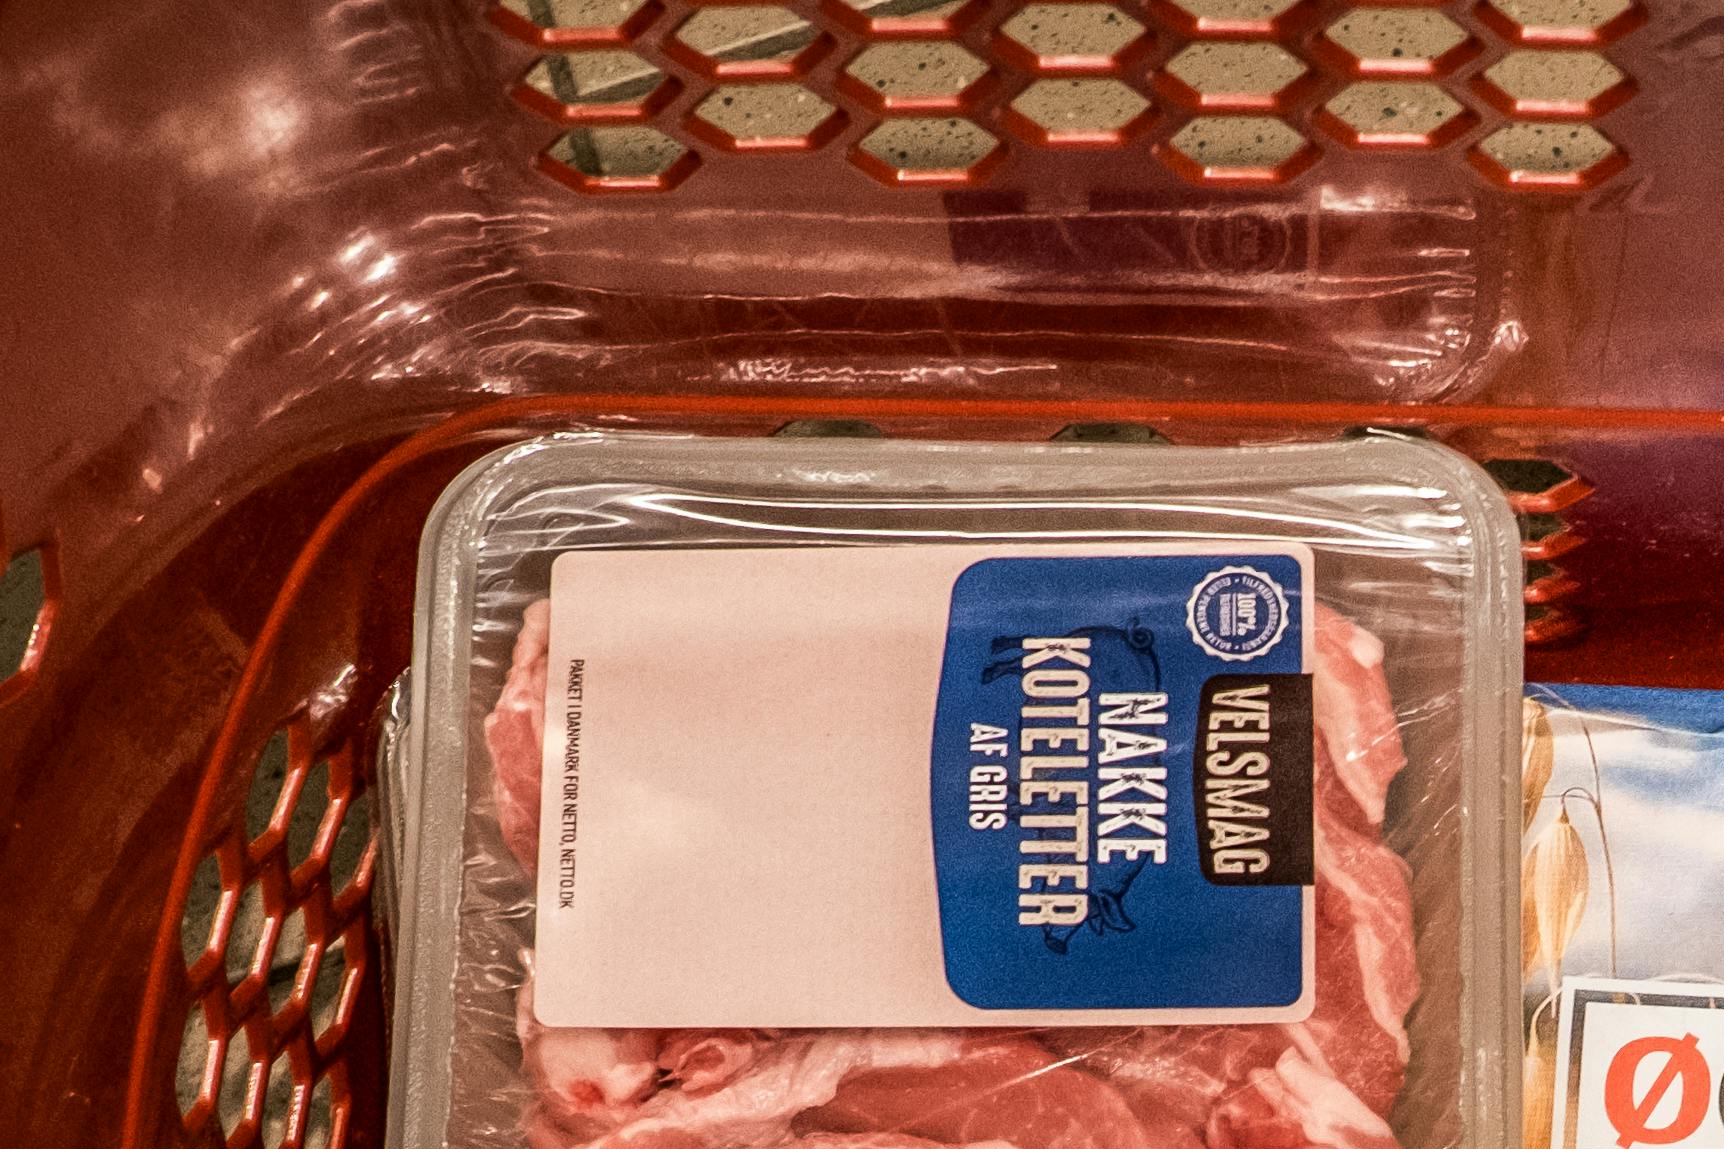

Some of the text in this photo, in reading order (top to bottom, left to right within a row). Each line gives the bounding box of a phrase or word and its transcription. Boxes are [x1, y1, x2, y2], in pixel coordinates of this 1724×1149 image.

[1237, 592, 1257, 636] 100%
[567, 659, 585, 701] PAKKET
[564, 711, 582, 773] DANMARK
[563, 775, 579, 800] FOR
[968, 722, 1007, 831] AF GRIS
[1018, 637, 1091, 926] KOTELETTER
[1098, 692, 1168, 865] NAKKE
[1205, 684, 1270, 876] VELSMAG
[559, 803, 578, 846] NETTO,
